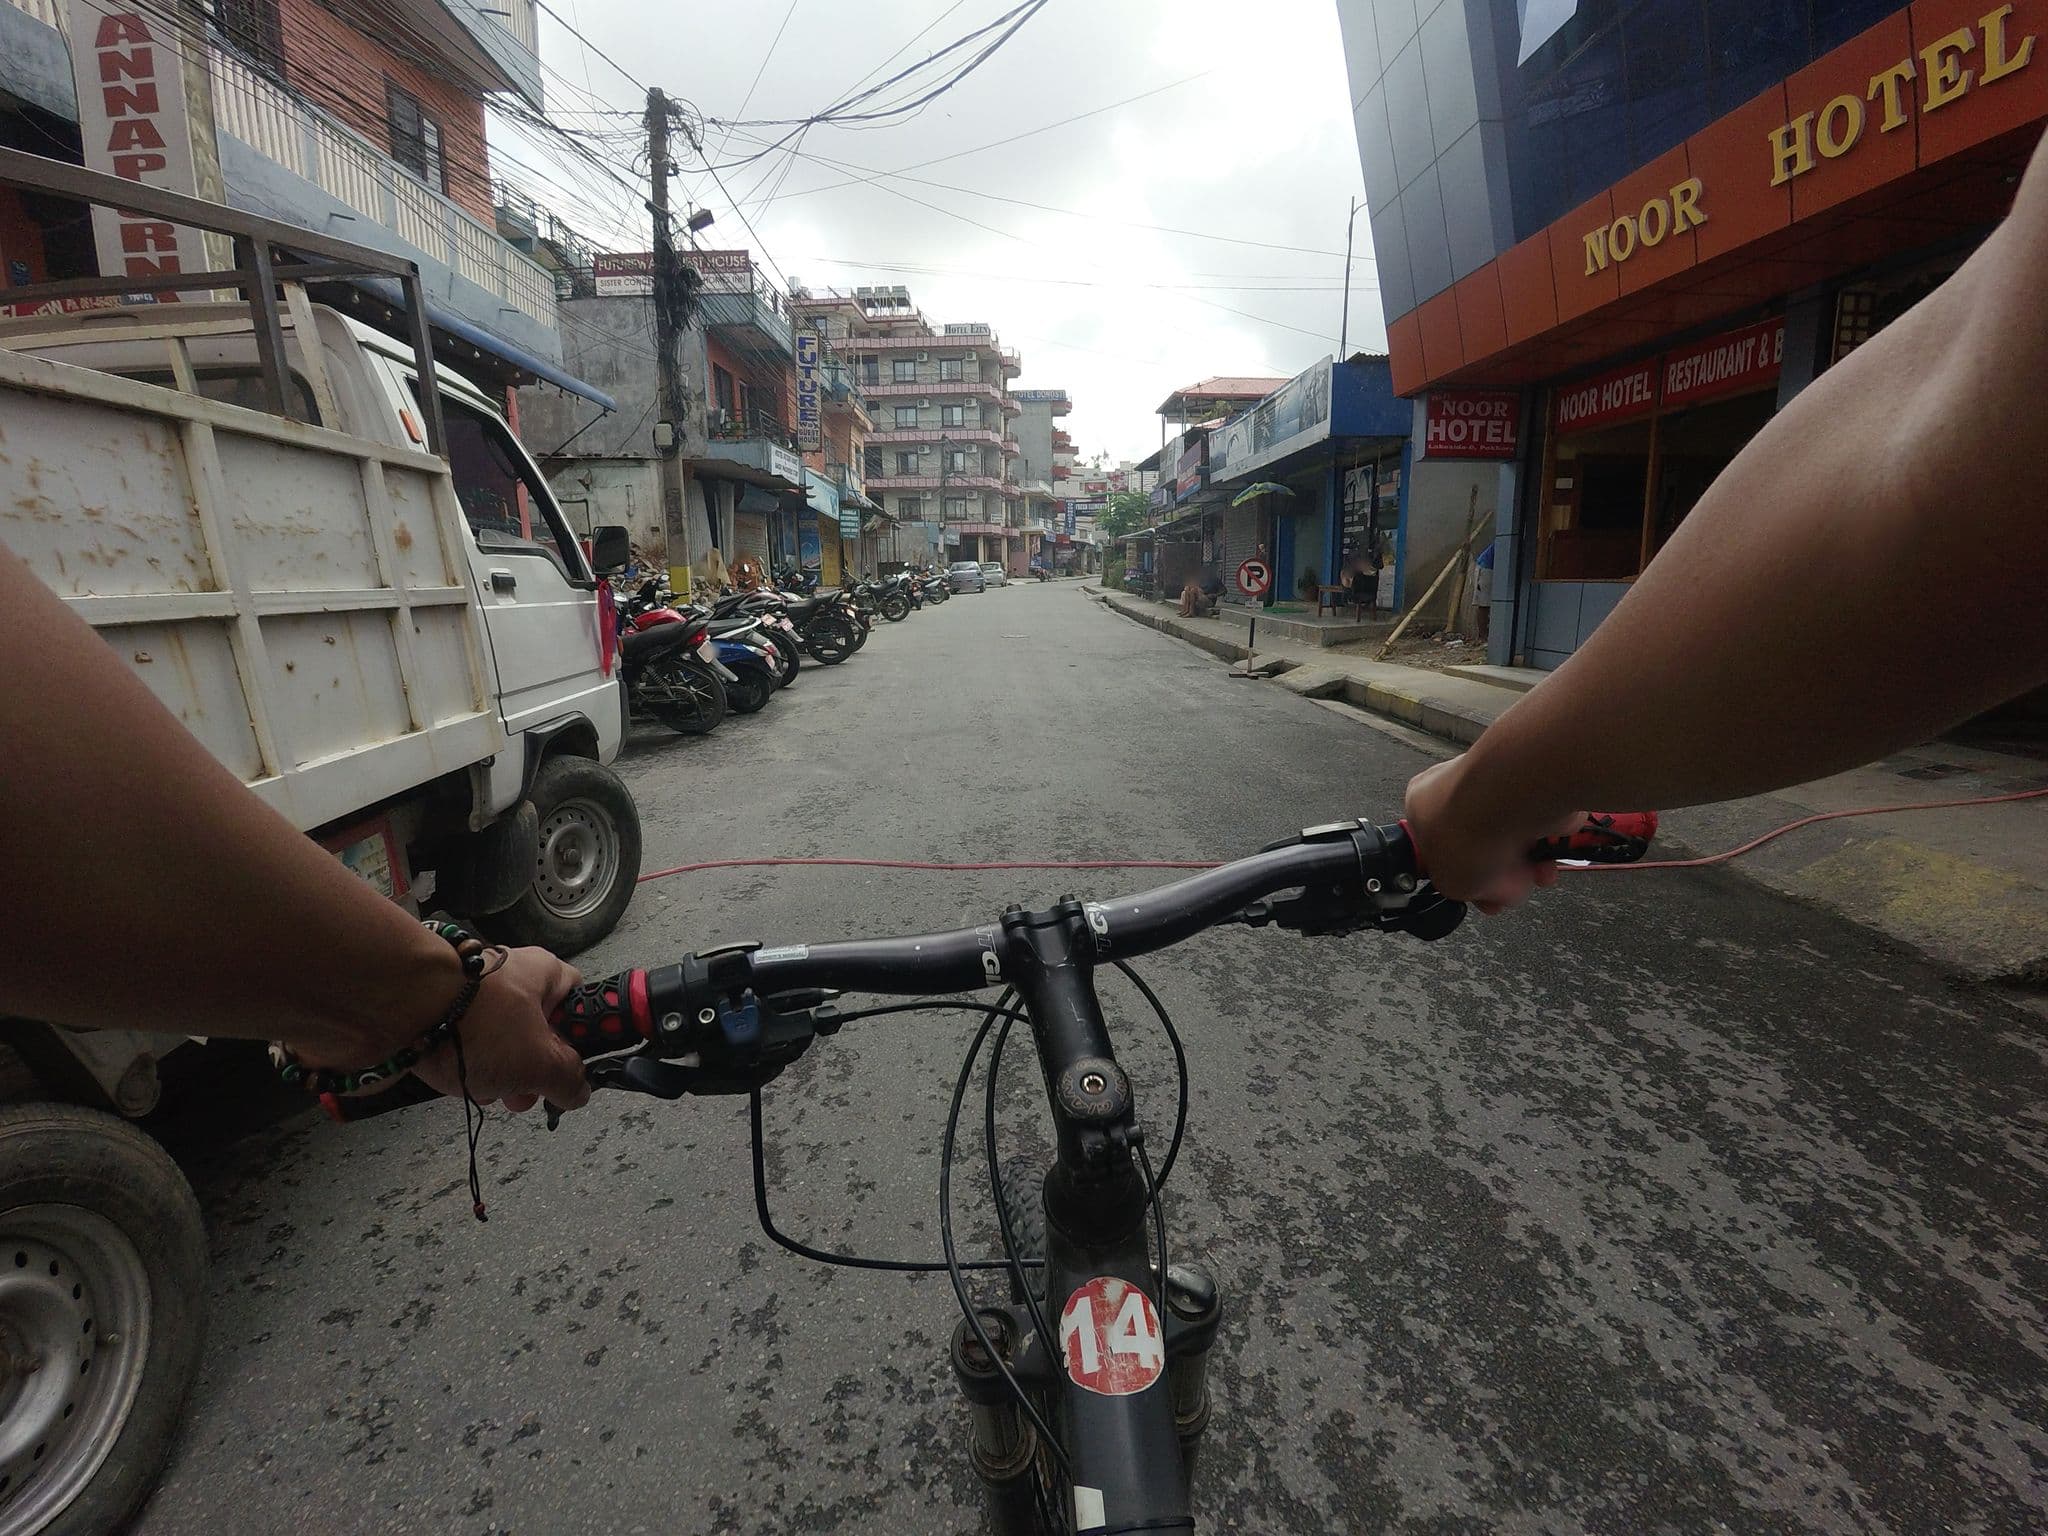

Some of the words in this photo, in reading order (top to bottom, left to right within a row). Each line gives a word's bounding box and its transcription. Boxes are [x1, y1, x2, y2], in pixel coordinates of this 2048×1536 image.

[1583, 177, 1708, 276] NOOR
[1768, 4, 2036, 187] HOTEL
[798, 337, 818, 421] FUTURE
[1667, 337, 1756, 395] RESTAURANT
[1758, 333, 1768, 369] &
[1441, 400, 1508, 417] NOOR
[1560, 387, 1598, 424] NOOR
[1601, 372, 1652, 412] HOTEL
[1427, 419, 1516, 443] HOTEL
[1061, 1292, 1160, 1375] 14
